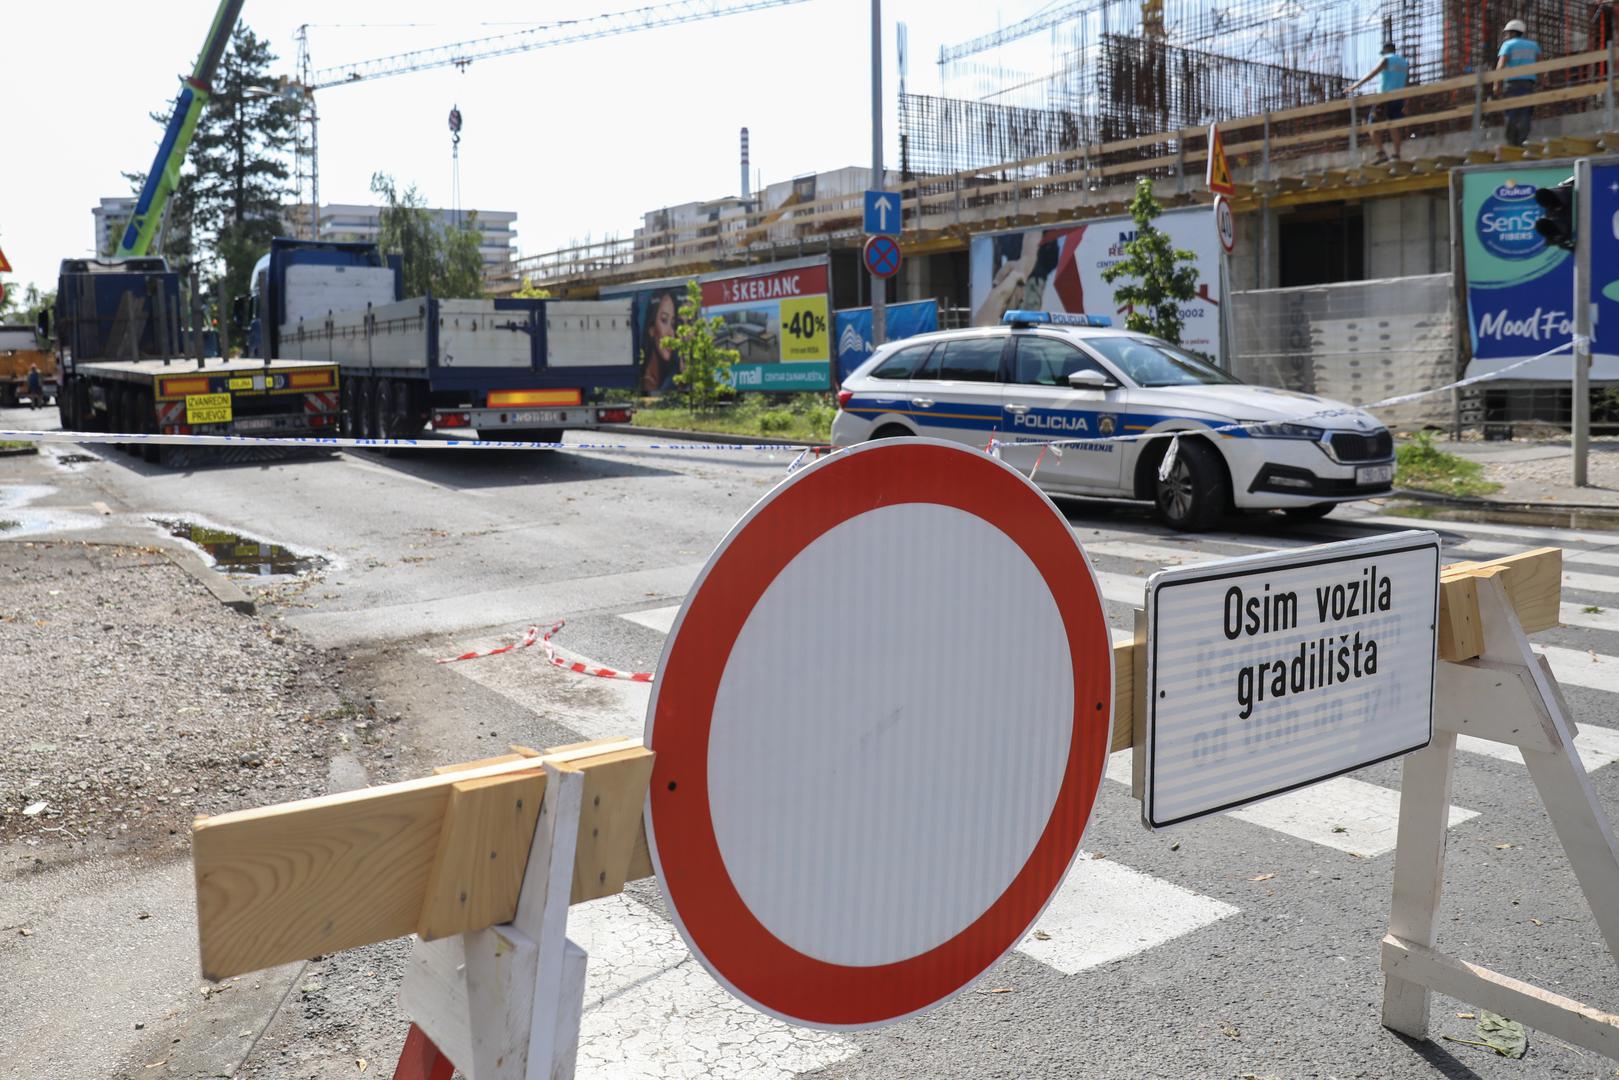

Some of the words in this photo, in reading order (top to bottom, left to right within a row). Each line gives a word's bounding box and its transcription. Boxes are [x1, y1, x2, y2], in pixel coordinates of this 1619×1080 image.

[1499, 186, 1533, 197] Dukat
[1220, 211, 1232, 238] 40
[731, 275, 801, 301] ŠKERJANC
[1052, 313, 1086, 325] POLICIJA
[191, 409, 228, 421] PRIJEVOZ
[1014, 414, 1089, 431] POLICIJA
[1223, 583, 1298, 640] Osim
[1316, 565, 1392, 622] vozila
[1237, 631, 1378, 720] gradilišta
